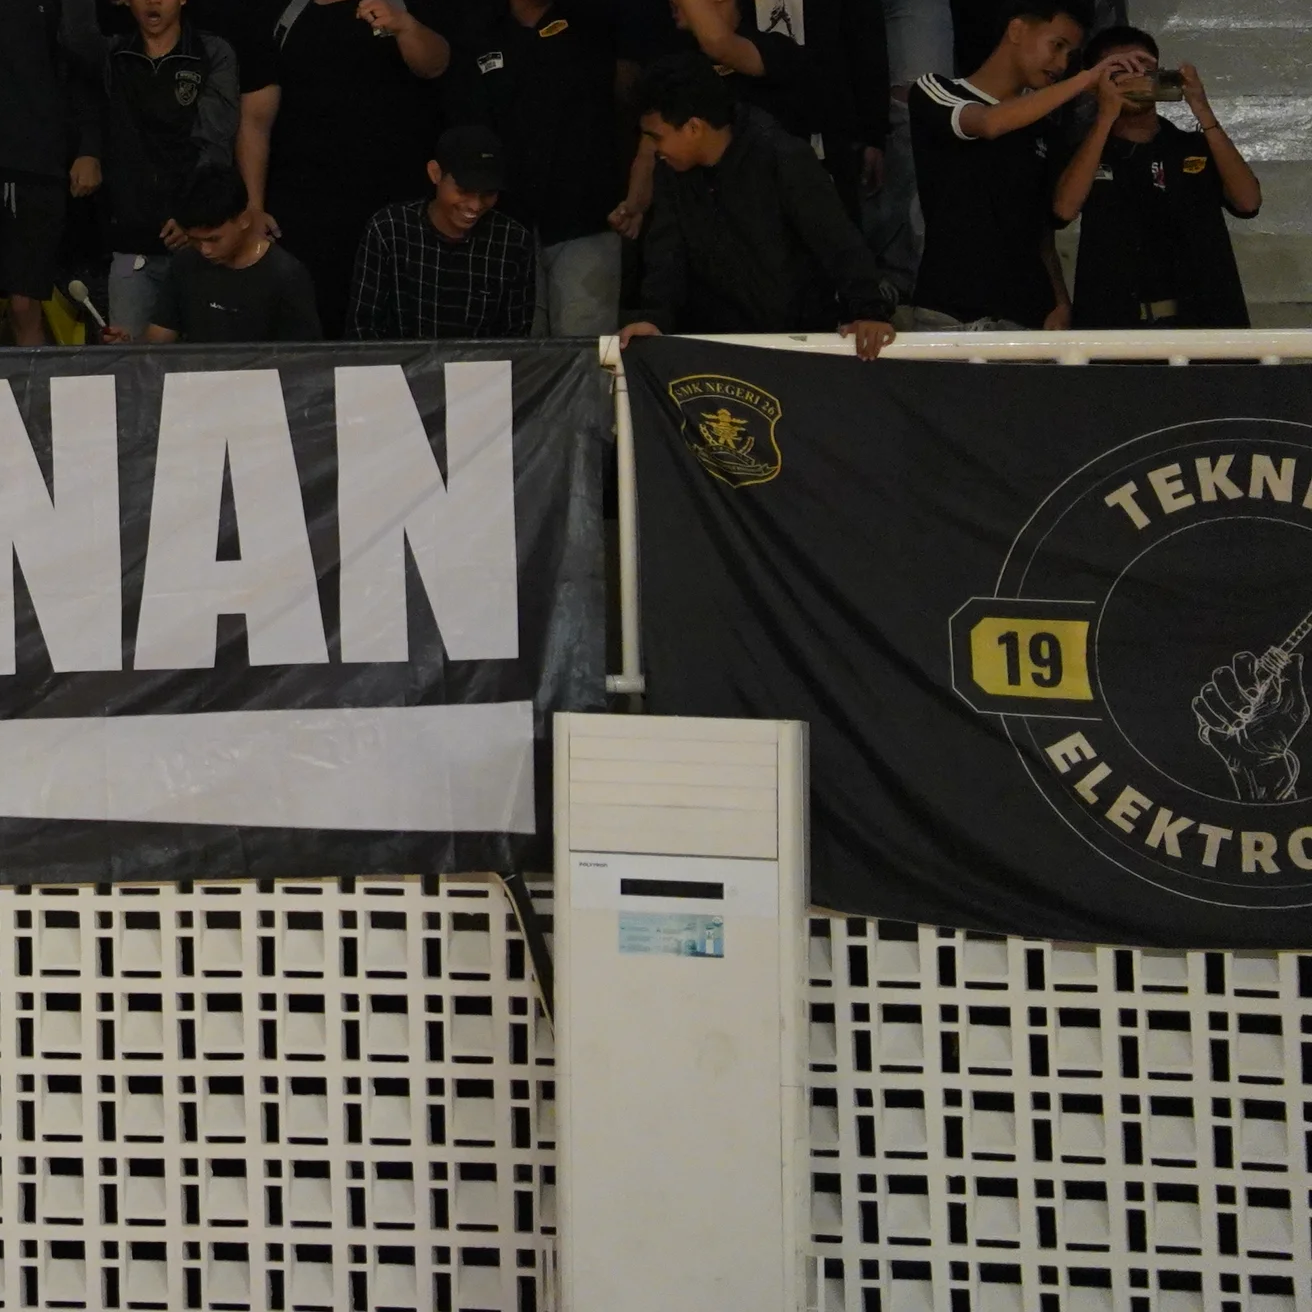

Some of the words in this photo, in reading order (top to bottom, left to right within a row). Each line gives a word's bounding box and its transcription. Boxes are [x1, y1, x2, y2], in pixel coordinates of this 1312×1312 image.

[675, 381, 703, 399] SMK
[705, 381, 761, 406] NEGERI
[761, 400, 776, 417] 26
[997, 630, 1064, 688] 19
